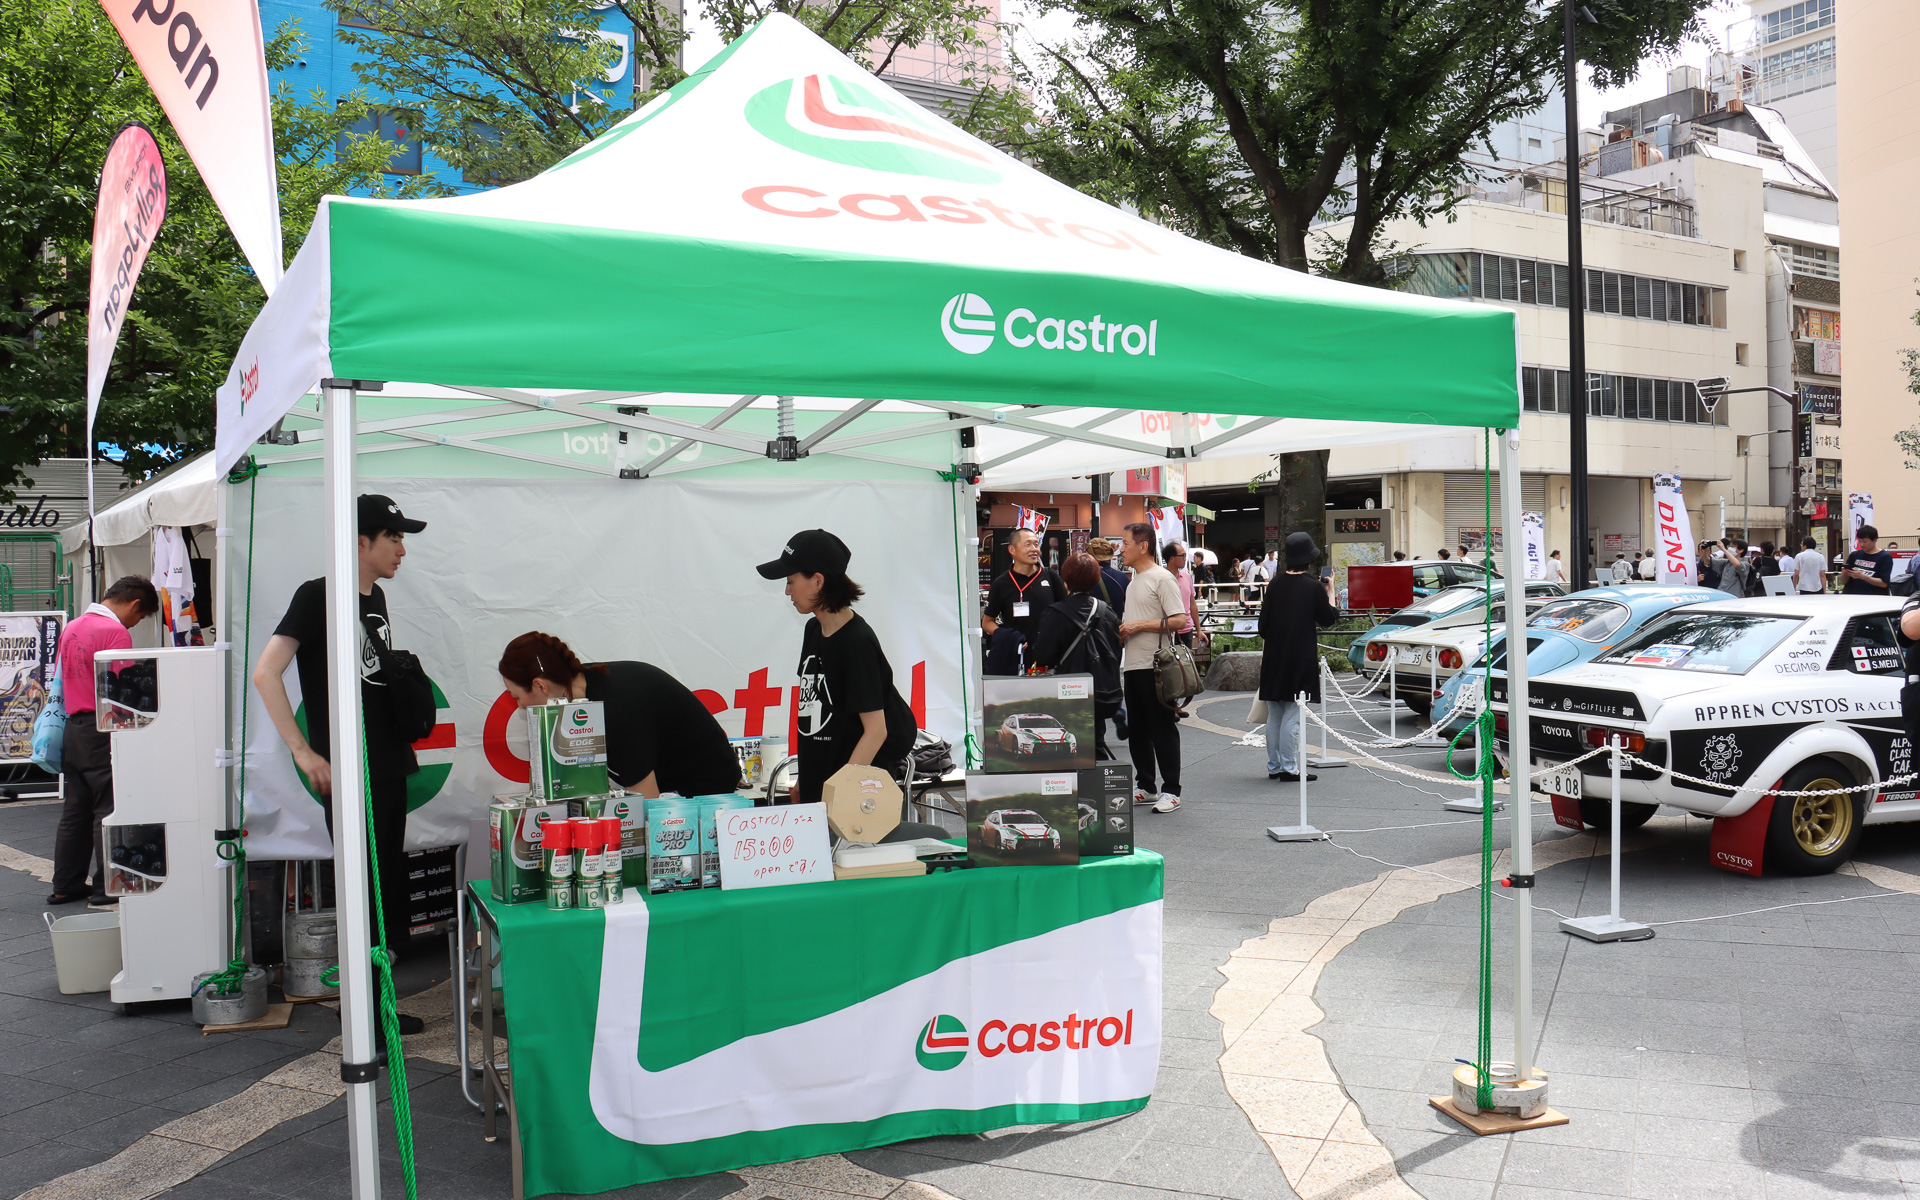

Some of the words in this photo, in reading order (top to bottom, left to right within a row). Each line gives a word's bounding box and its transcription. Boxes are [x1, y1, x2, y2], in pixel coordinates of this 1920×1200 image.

[741, 185, 1162, 257] Castrol
[1003, 307, 1158, 356] Castrol
[1341, 520, 1380, 531] 14:44
[1658, 500, 1687, 585] DENS
[1788, 648, 1821, 658] amon
[1867, 646, 1899, 656] T.KAWAI
[1695, 703, 1765, 721] APPREN
[1772, 698, 1849, 717] CVSTOS
[1541, 725, 1572, 738] TOYOTA
[569, 738, 594, 747] EDGE
[1885, 793, 1916, 801] FERODO
[728, 810, 788, 835] Castrol
[656, 829, 694, 843] 水はじき
[662, 840, 686, 850] PRO
[734, 835, 794, 861] 15:00
[1716, 851, 1753, 868] CVSTOS
[754, 866, 781, 879] open
[977, 1008, 1133, 1058] Castrol
